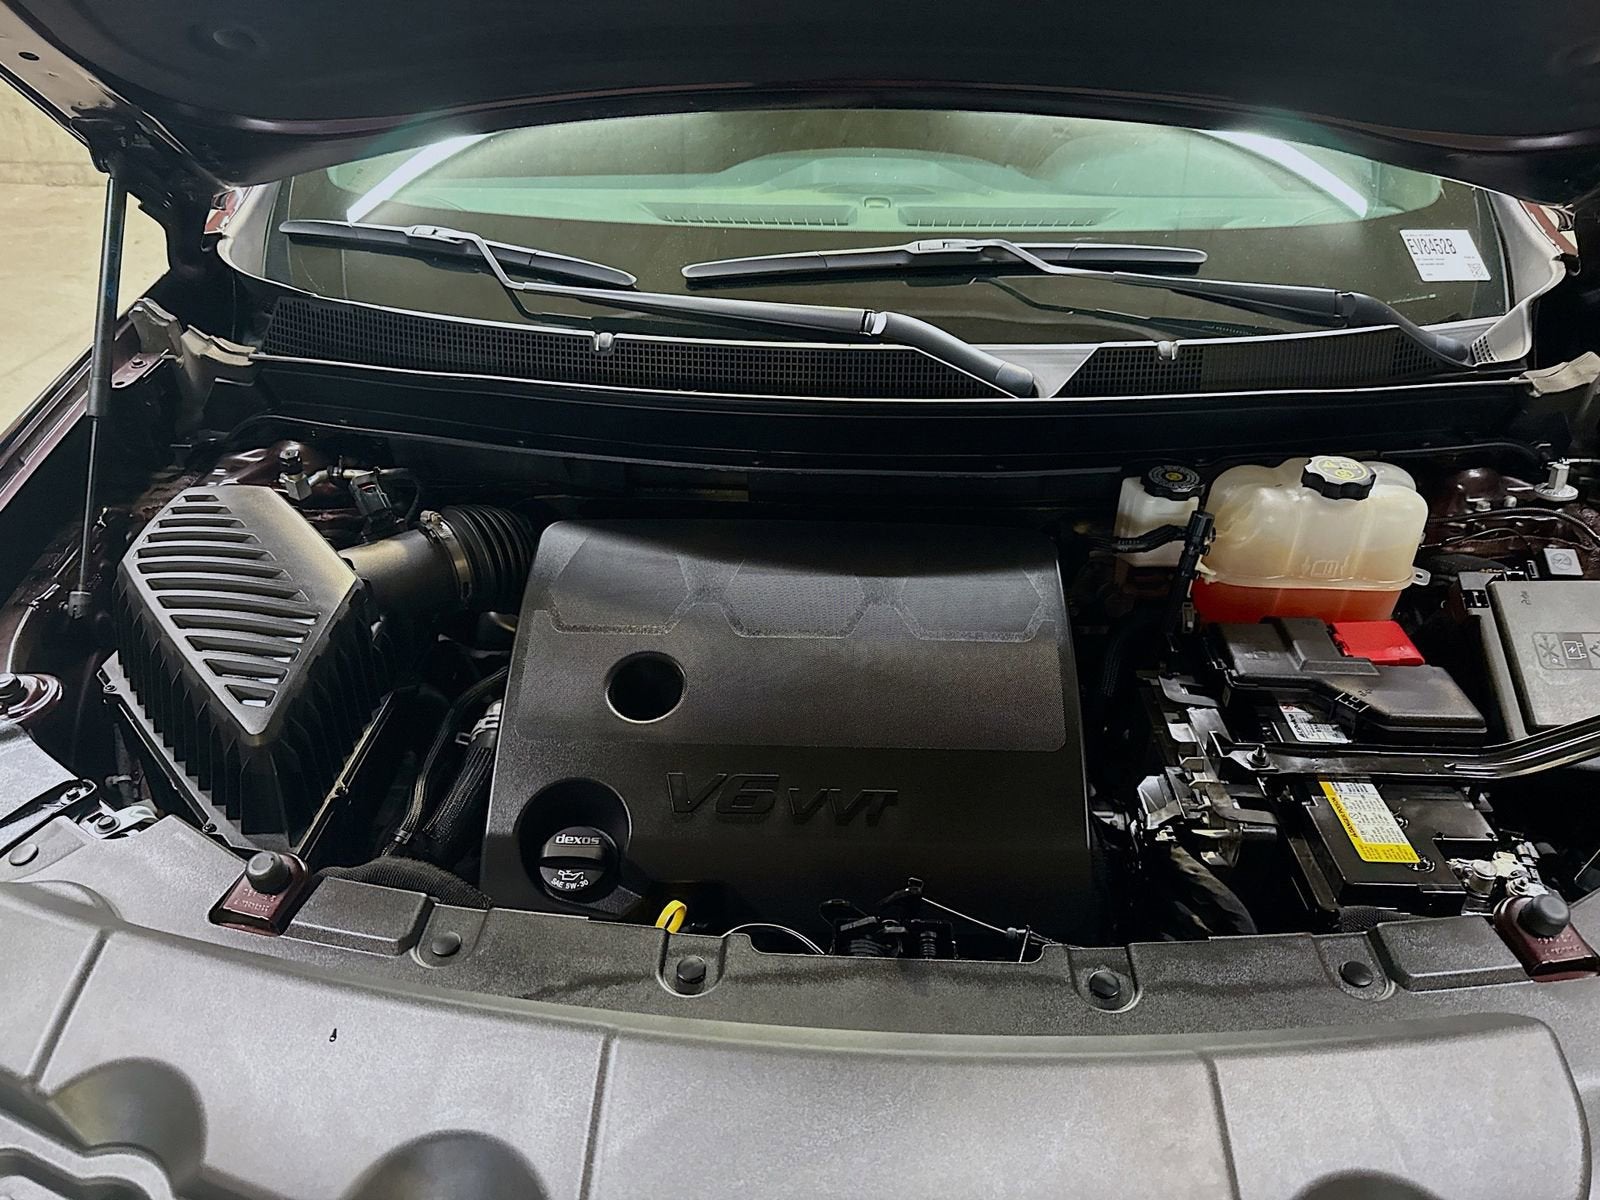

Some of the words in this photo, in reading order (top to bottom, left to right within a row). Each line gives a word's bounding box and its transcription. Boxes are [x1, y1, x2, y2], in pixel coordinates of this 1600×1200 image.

[666, 772, 780, 820] V6
[788, 787, 899, 825] VVT
[555, 834, 601, 845] dexos
[551, 878, 565, 889] SAE
[565, 880, 589, 890] 5W-30
